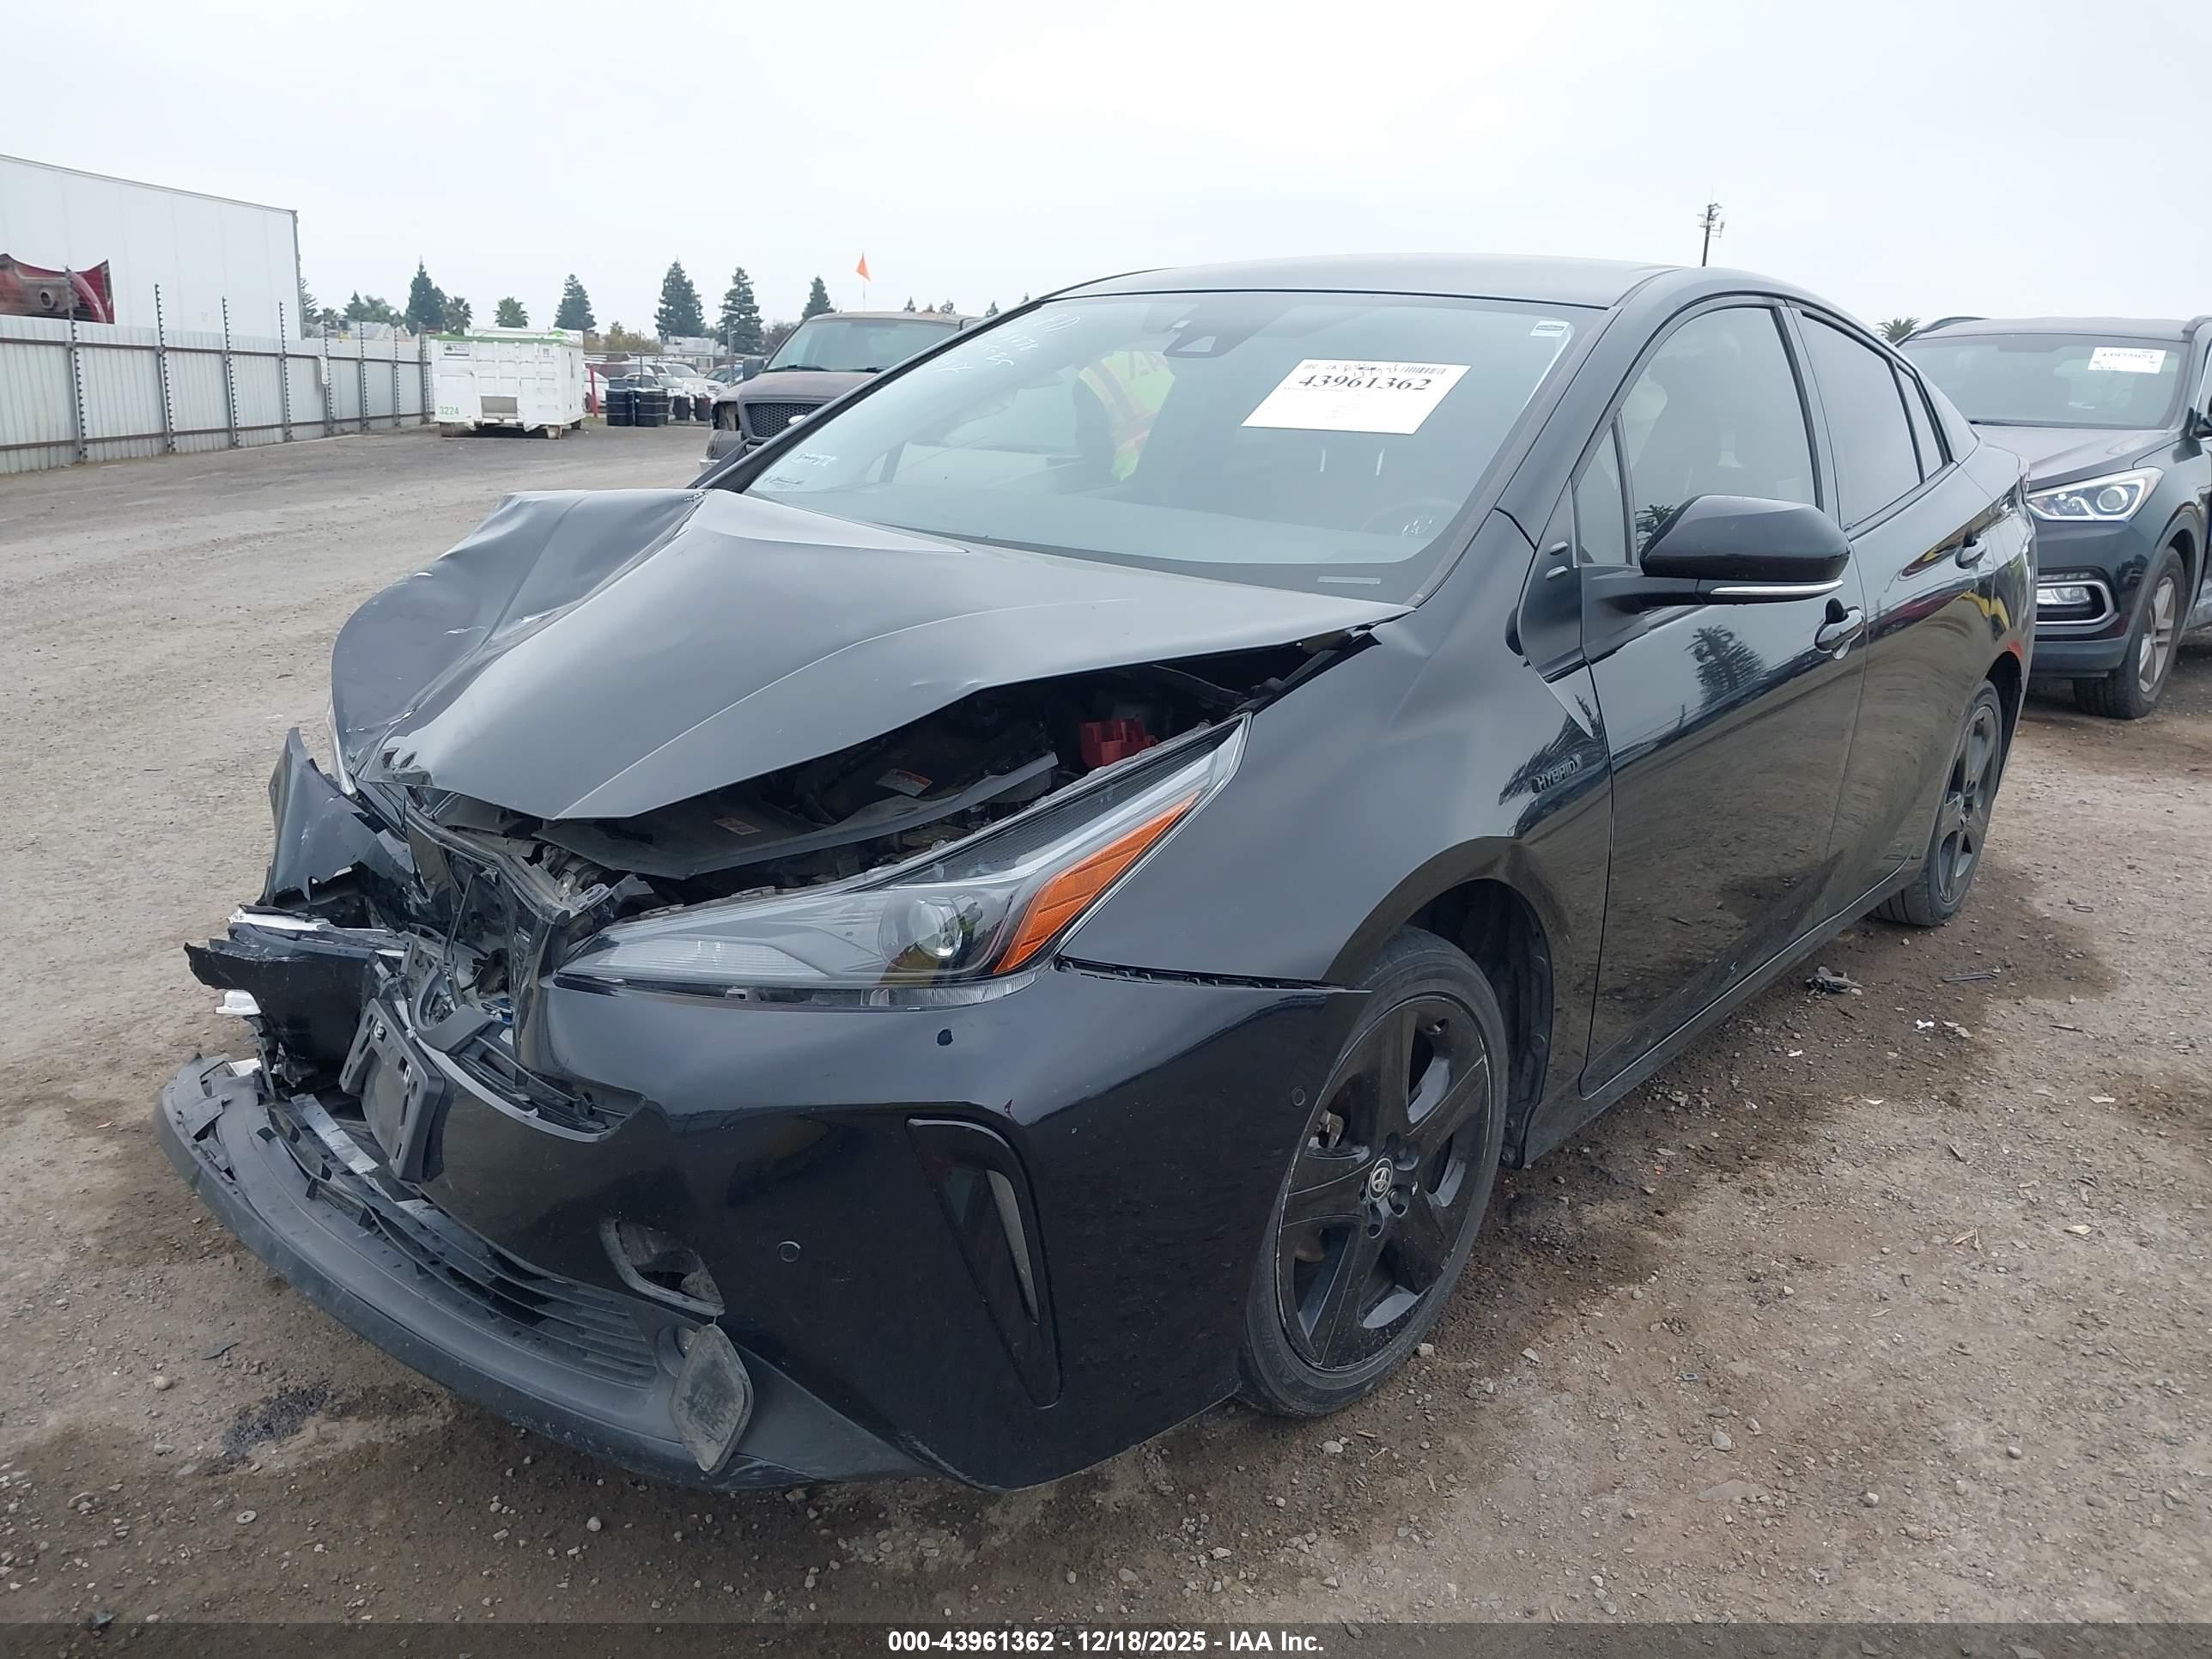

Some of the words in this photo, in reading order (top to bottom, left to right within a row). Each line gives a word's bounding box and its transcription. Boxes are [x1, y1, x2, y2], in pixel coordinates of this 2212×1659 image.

[1297, 374, 1432, 391] 43961362
[439, 405, 459, 416] 3224
[1536, 760, 1576, 791] HYBRID
